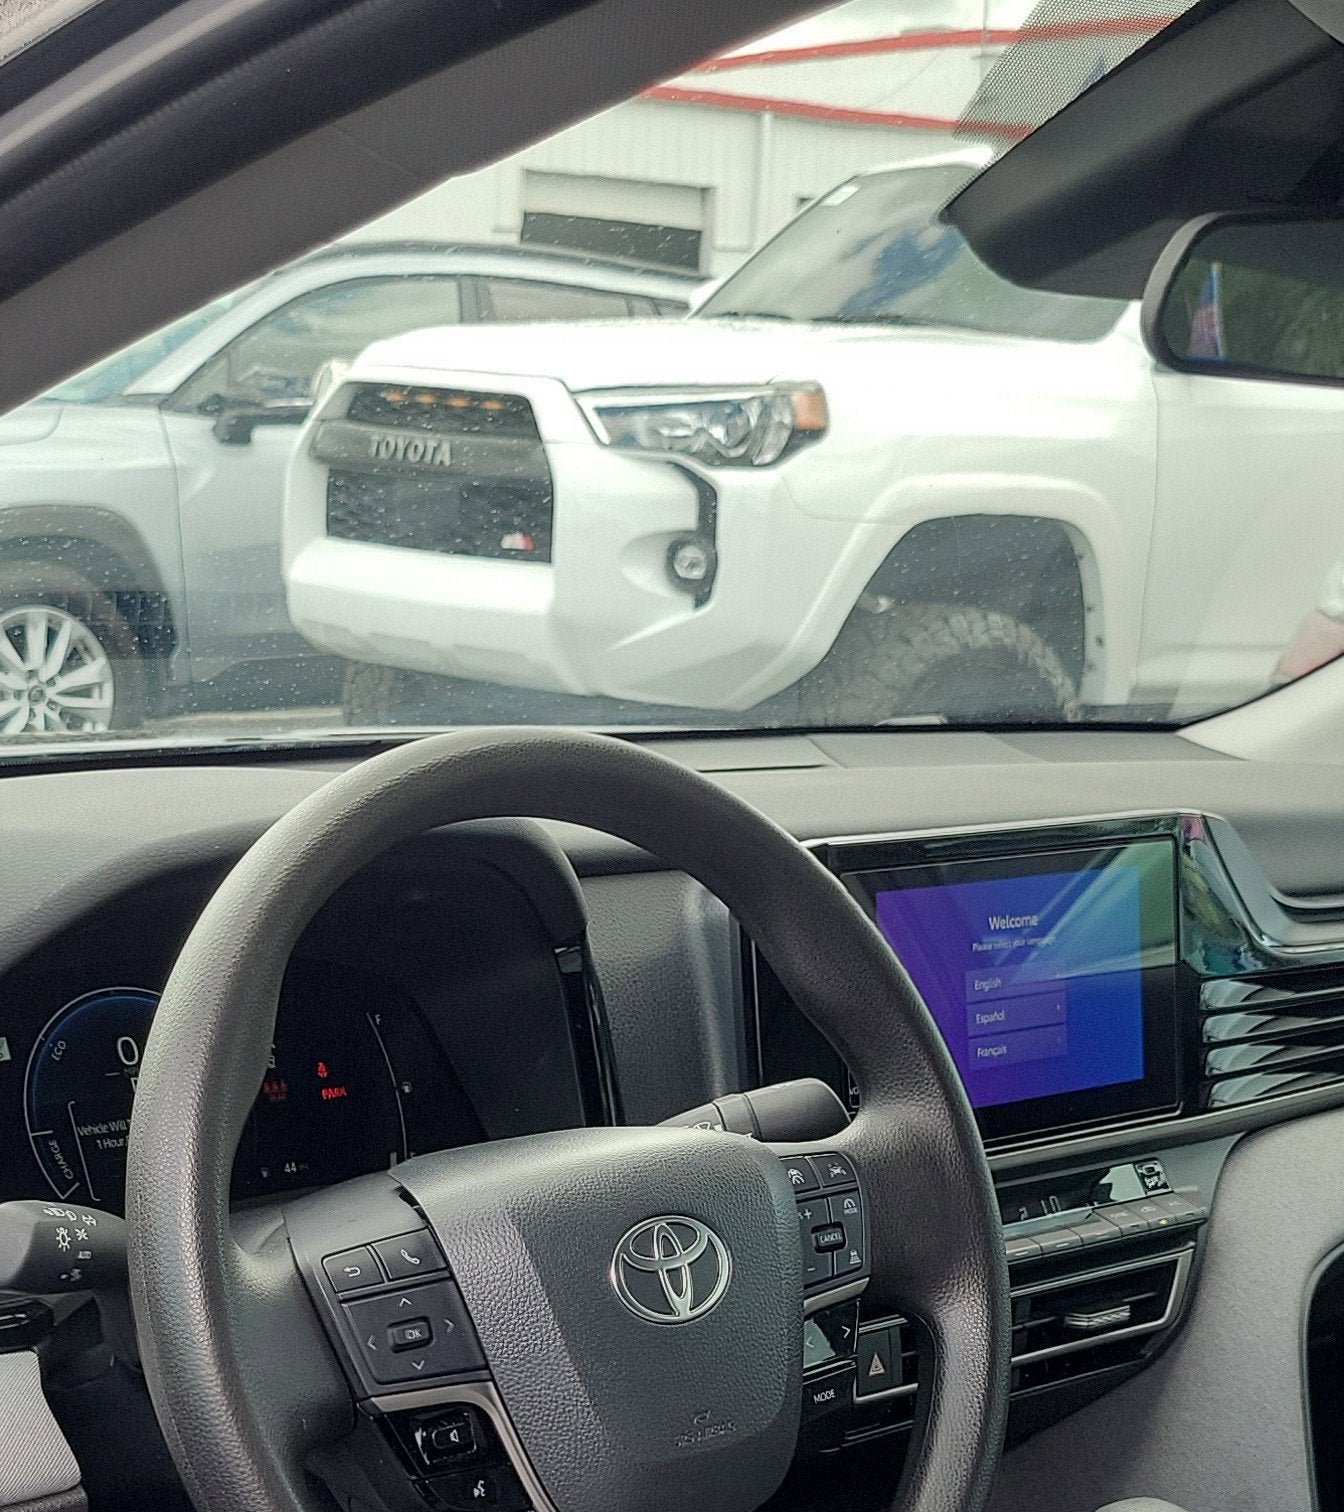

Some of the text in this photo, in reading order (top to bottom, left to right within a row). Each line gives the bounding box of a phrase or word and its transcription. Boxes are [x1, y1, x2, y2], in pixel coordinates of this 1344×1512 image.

[369, 434, 453, 468] TOYOTA
[988, 914, 1038, 931] Welcome
[974, 977, 1002, 992] English
[975, 1010, 1005, 1025] Español
[977, 1045, 1007, 1059] Français
[76, 1121, 109, 1137] Vehicle
[819, 1231, 843, 1244] CANCEL
[406, 1327, 423, 1340] OK
[813, 1388, 836, 1403] MODE
